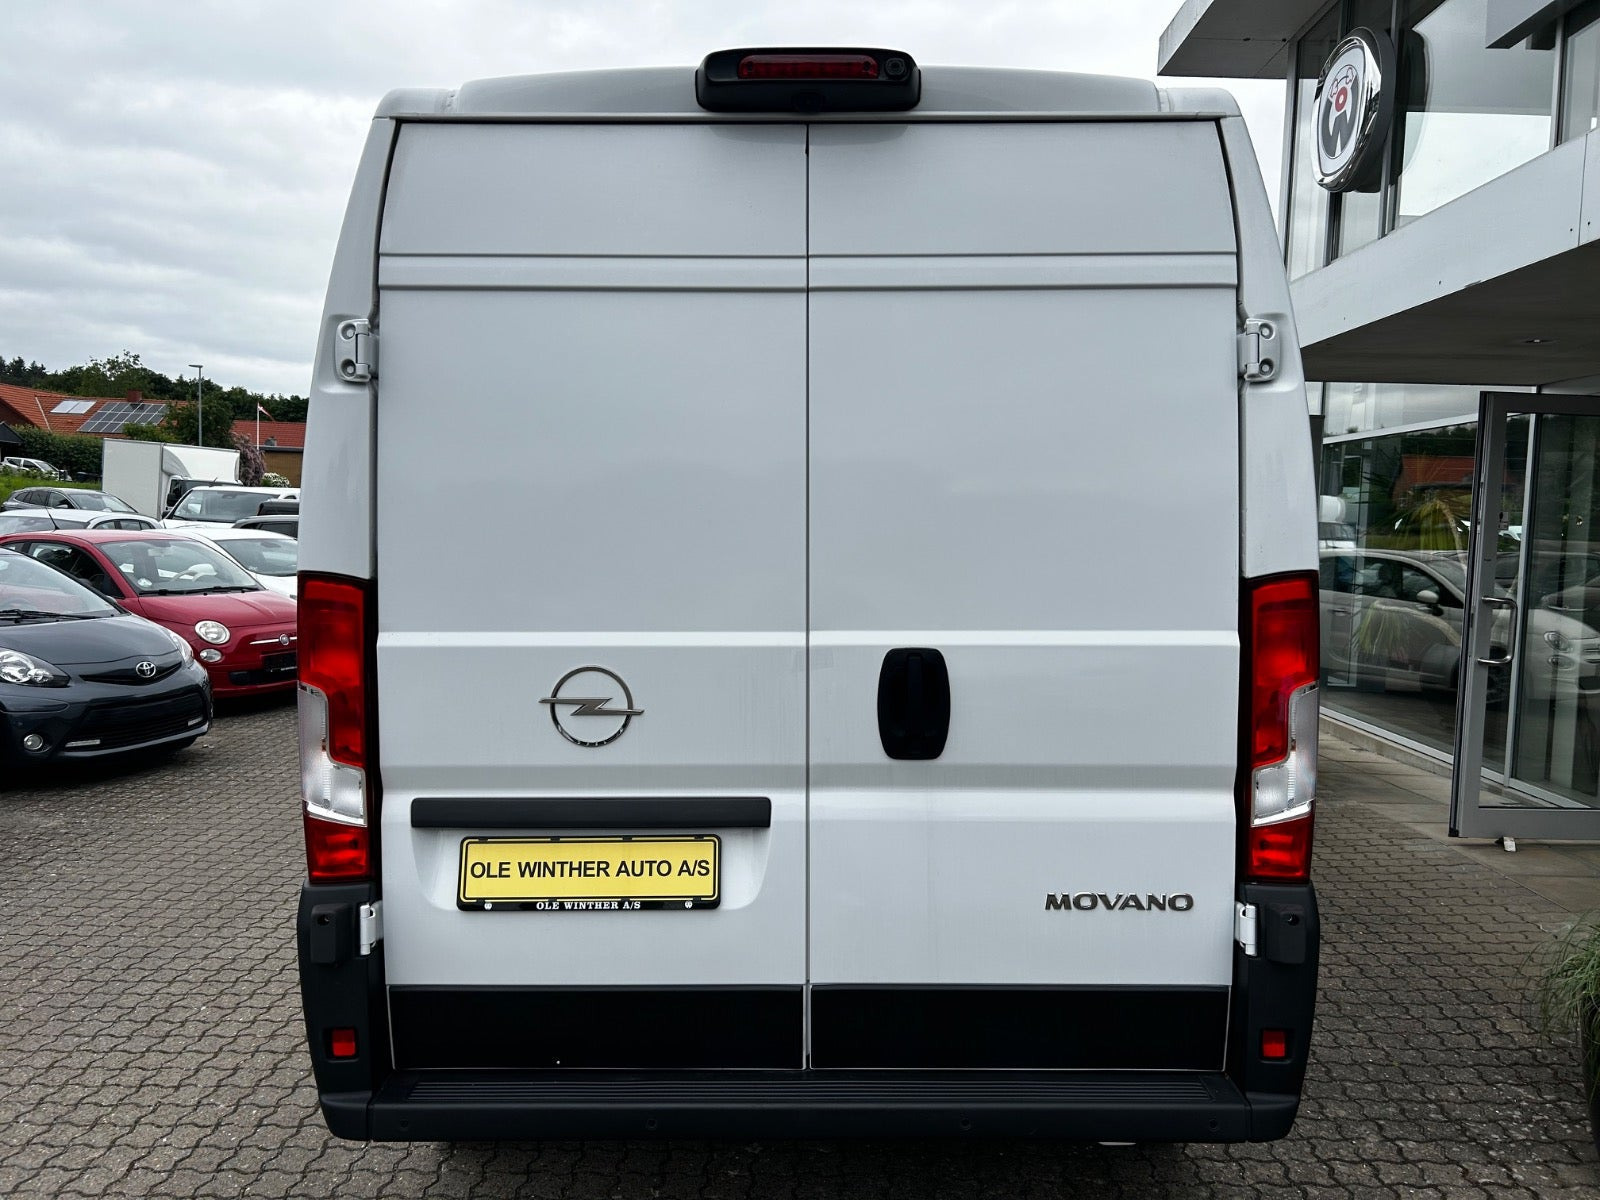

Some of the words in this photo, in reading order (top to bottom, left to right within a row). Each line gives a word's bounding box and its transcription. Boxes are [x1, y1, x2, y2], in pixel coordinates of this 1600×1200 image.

[470, 861, 511, 878] OLE
[518, 860, 610, 878] WINTHER
[615, 860, 672, 876] AUTO
[677, 859, 710, 877] A/S
[536, 901, 559, 910] OLE
[564, 901, 618, 909] WINTHER
[622, 901, 641, 910] A/S
[1045, 891, 1194, 912] MOVANO
